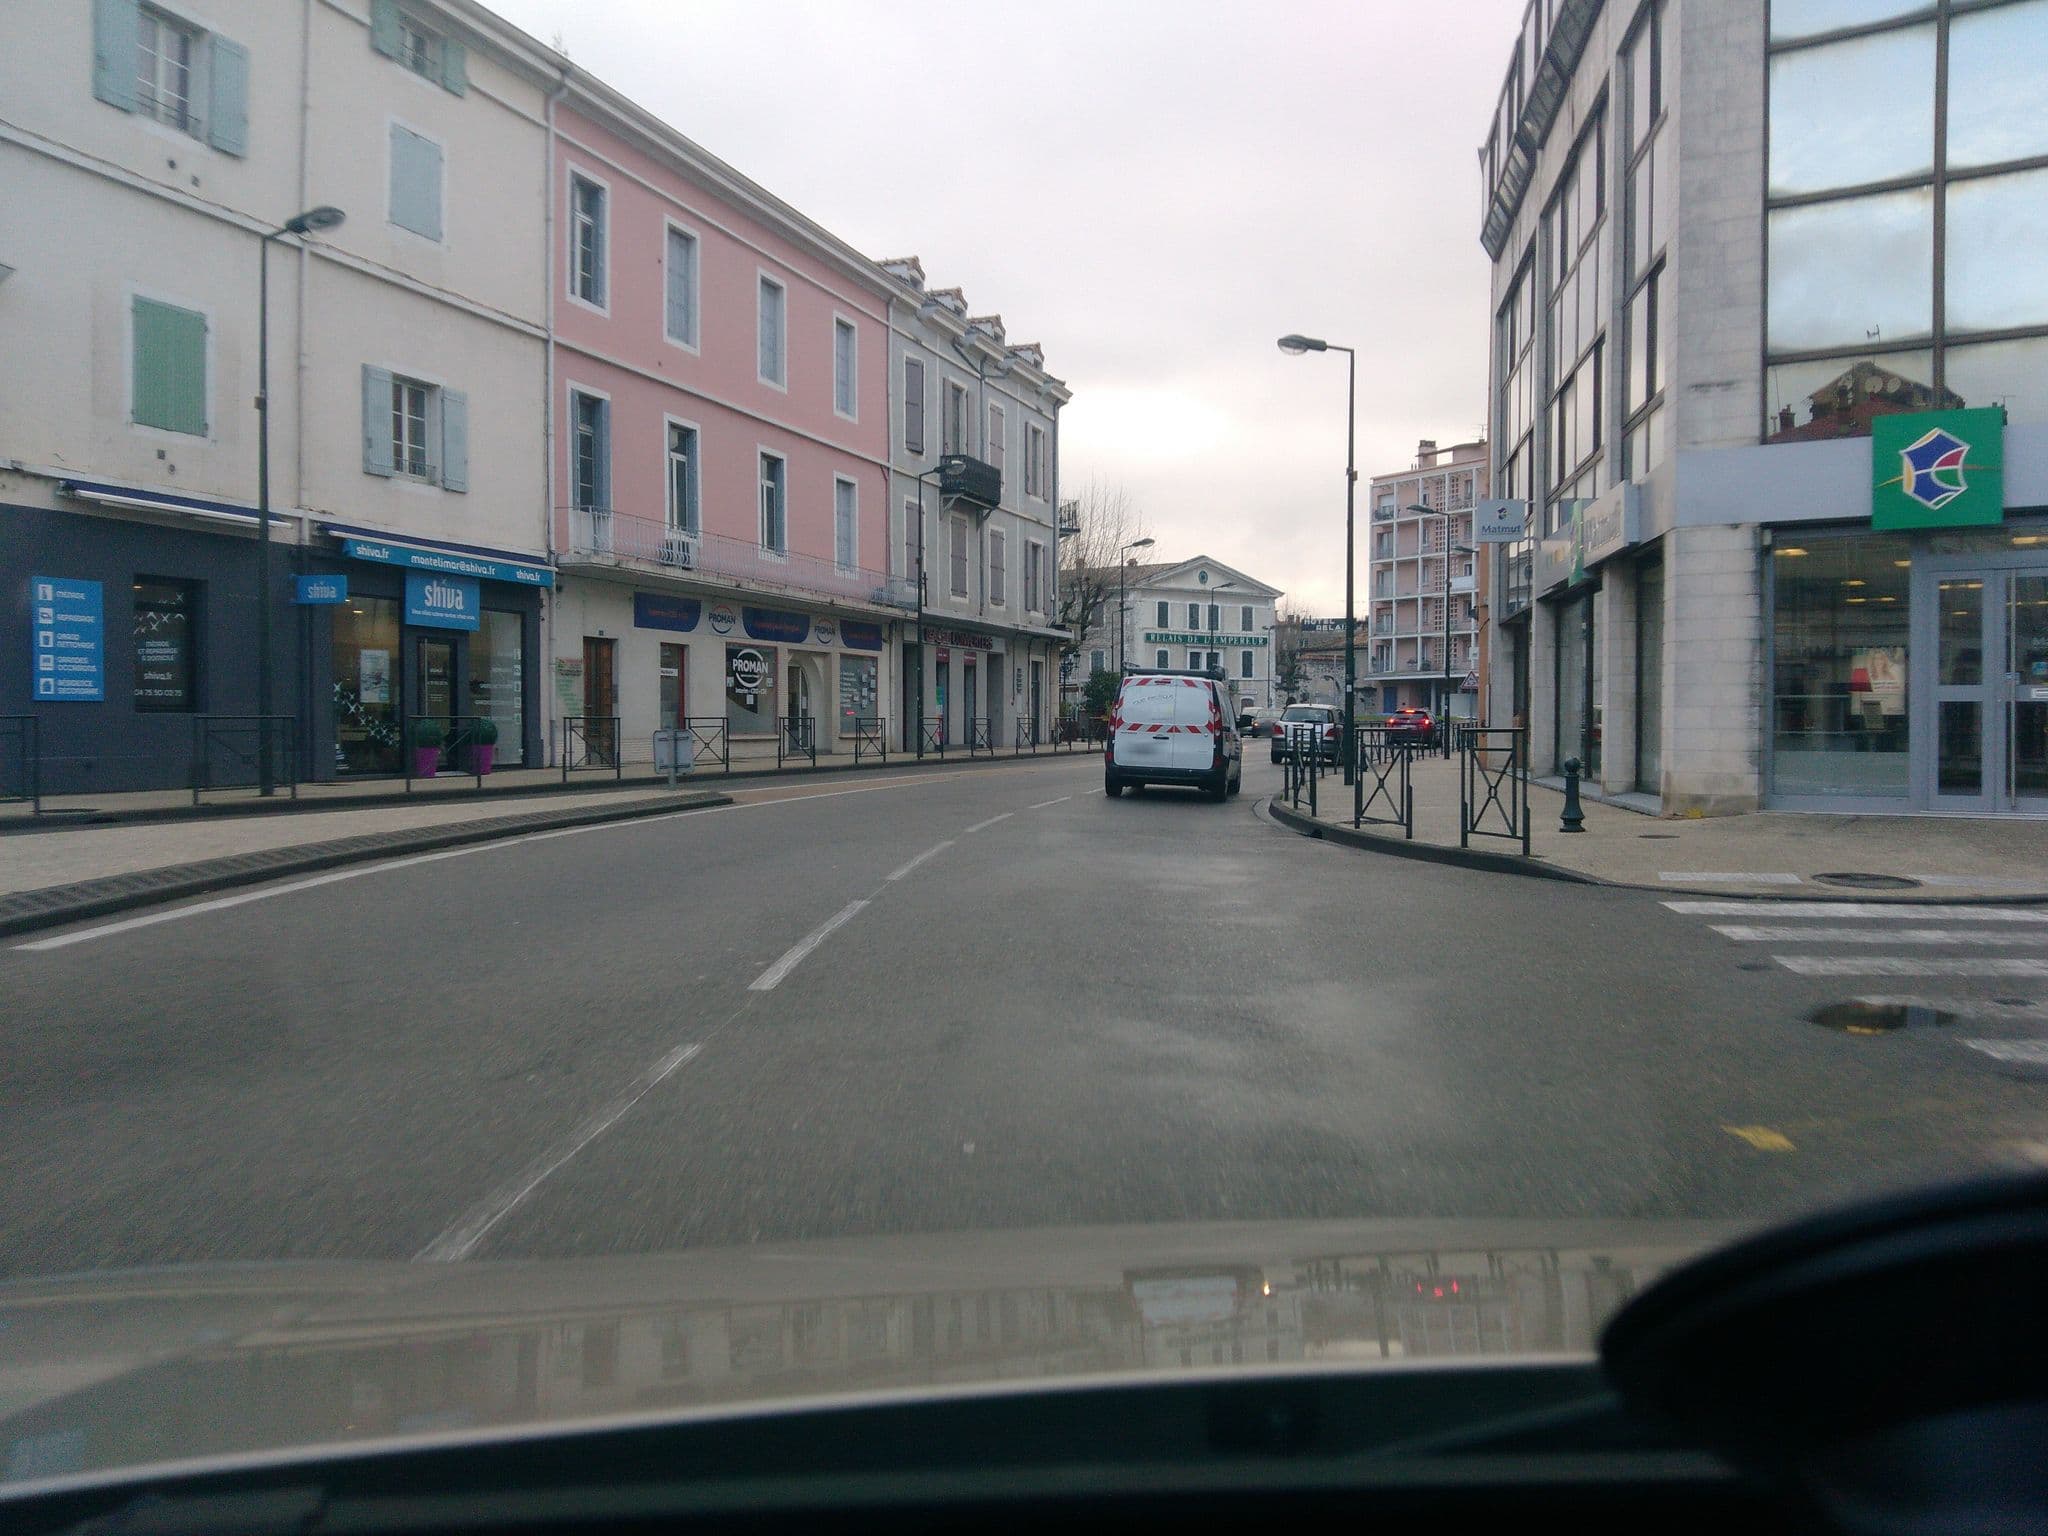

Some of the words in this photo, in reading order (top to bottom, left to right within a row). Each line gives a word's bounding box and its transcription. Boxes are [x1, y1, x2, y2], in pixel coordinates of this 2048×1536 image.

[1481, 524, 1521, 534] Matmut
[356, 544, 390, 560] shiva.fr
[410, 554, 496, 575] montelimar@shiva.fr
[516, 569, 541, 582] shiva.fr
[307, 582, 337, 599] shiva
[424, 579, 464, 610] shiva
[708, 612, 736, 624] PROMAN
[1304, 617, 1335, 625] HOTEL
[814, 624, 836, 636] PROMAN
[1150, 634, 1183, 643] RELAIS
[732, 658, 769, 673] PROMAN
